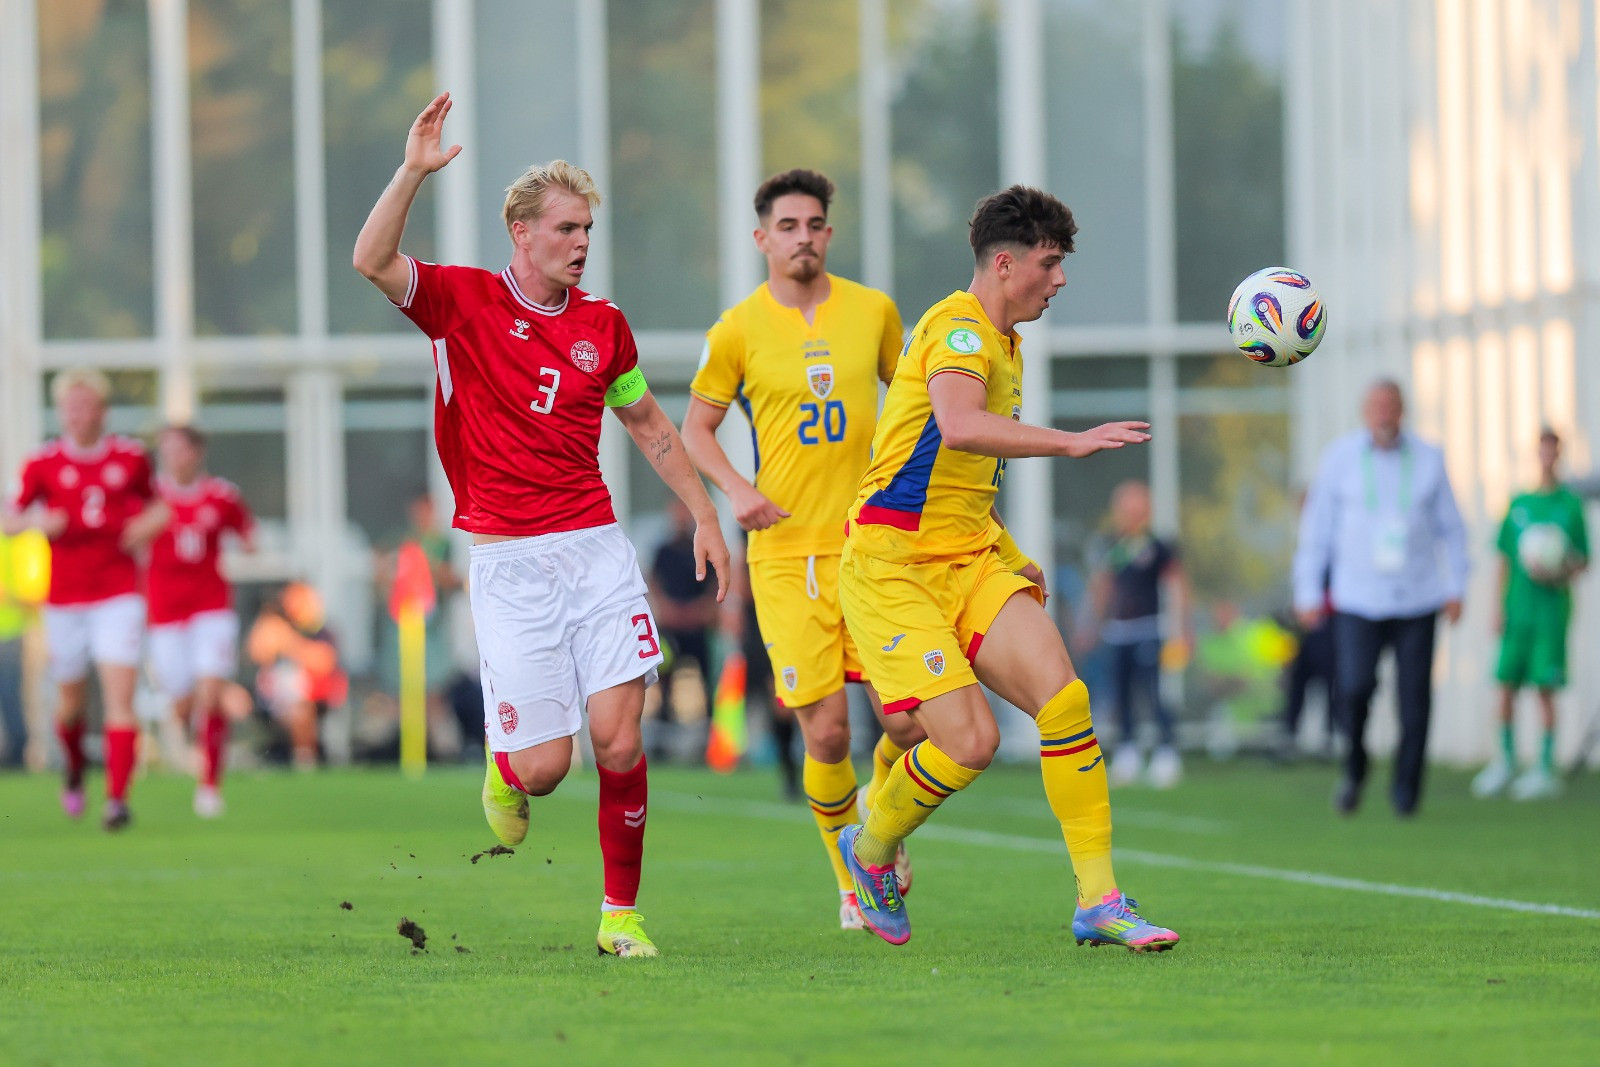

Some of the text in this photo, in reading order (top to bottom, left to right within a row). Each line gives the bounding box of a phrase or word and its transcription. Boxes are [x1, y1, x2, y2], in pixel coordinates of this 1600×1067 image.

[529, 366, 561, 415] 3
[798, 400, 846, 445] 20
[631, 613, 660, 659] 3
